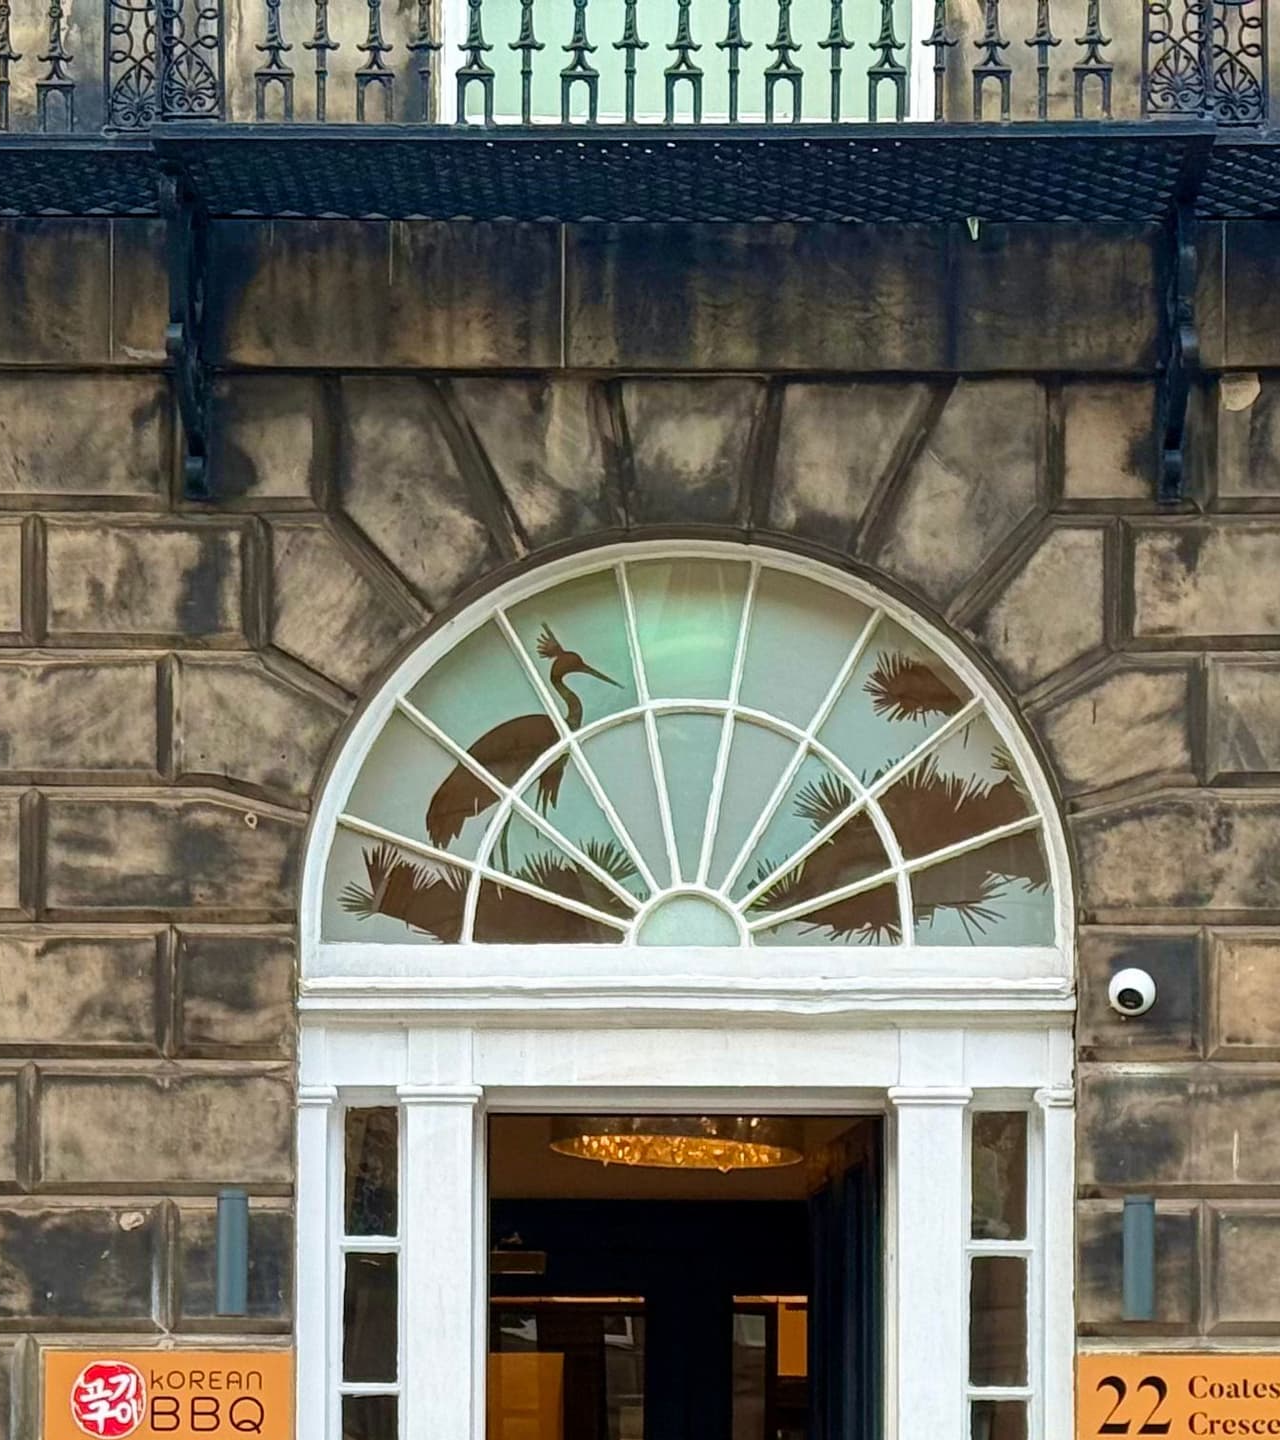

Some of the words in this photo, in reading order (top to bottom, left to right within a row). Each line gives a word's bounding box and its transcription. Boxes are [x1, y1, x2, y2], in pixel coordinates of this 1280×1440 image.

[79, 1372, 138, 1402] 고기
[1095, 1375, 1173, 1435] 22
[80, 1400, 138, 1434] 구이
[150, 1396, 265, 1434] BBQ
